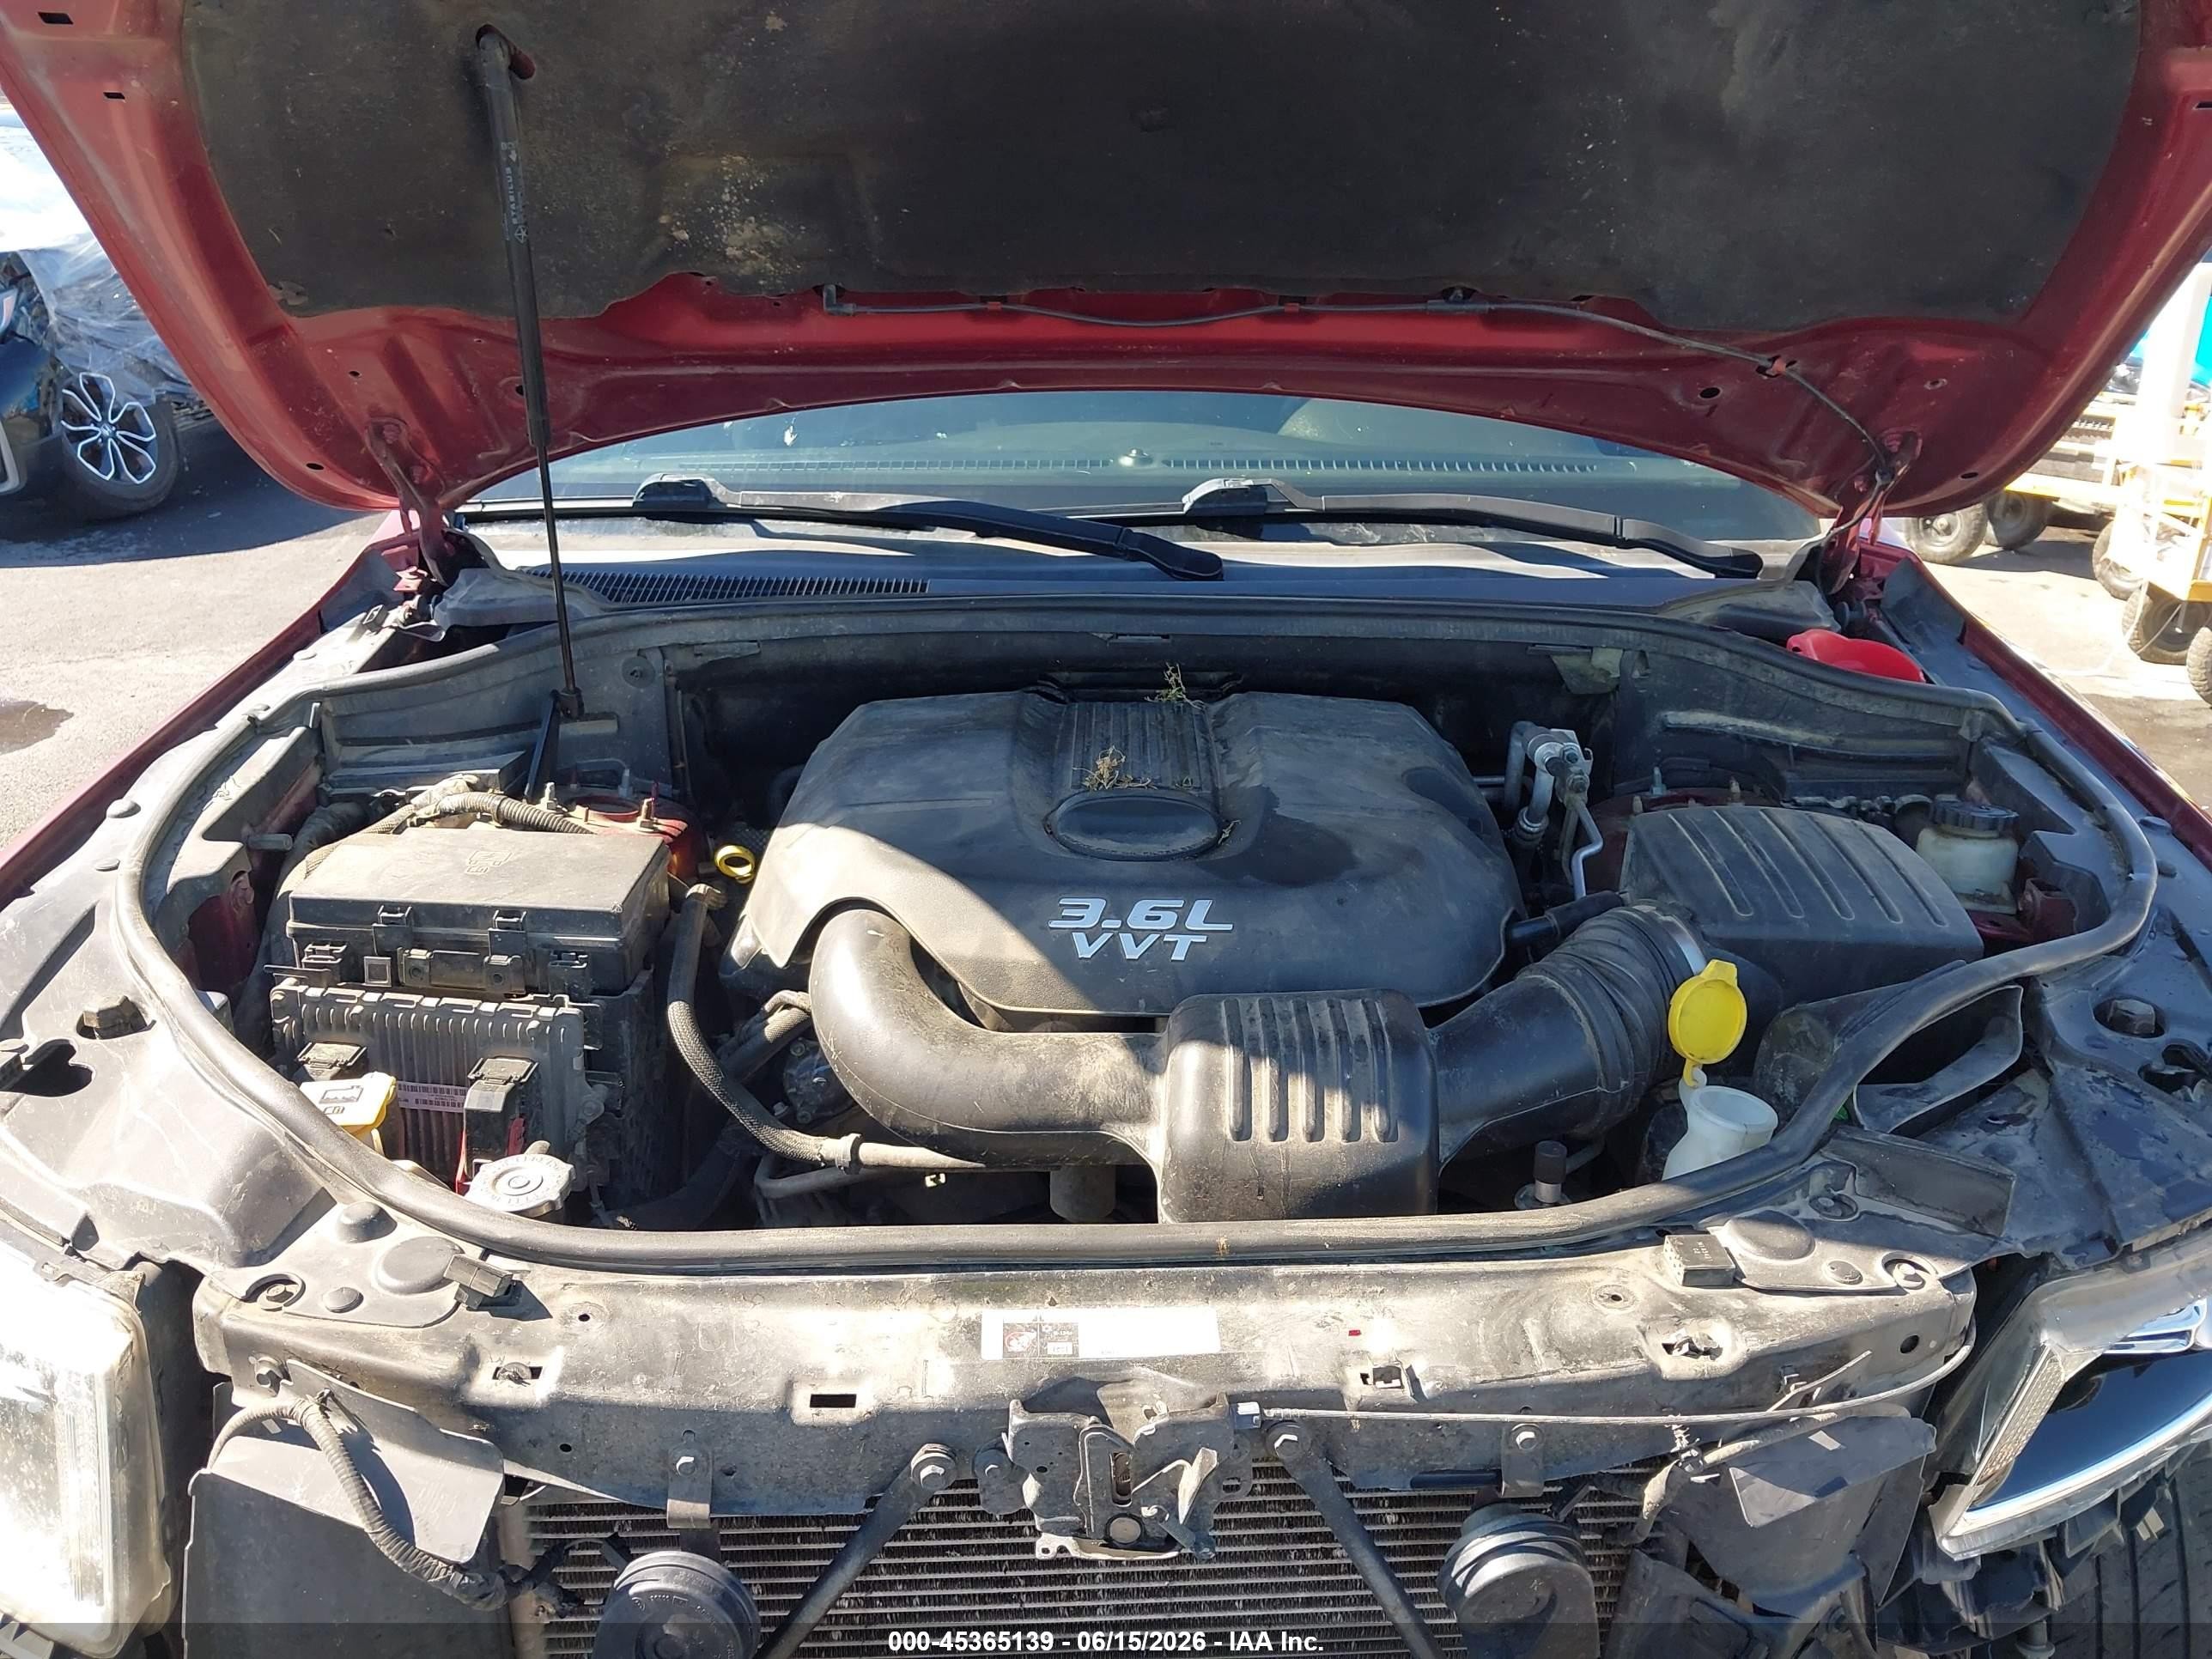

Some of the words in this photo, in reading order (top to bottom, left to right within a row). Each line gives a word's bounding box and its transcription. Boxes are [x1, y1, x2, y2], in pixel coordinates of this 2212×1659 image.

[505, 167, 518, 224] STABILUS
[1048, 896, 1234, 932] 3.6L
[1071, 932, 1208, 961] VVT
